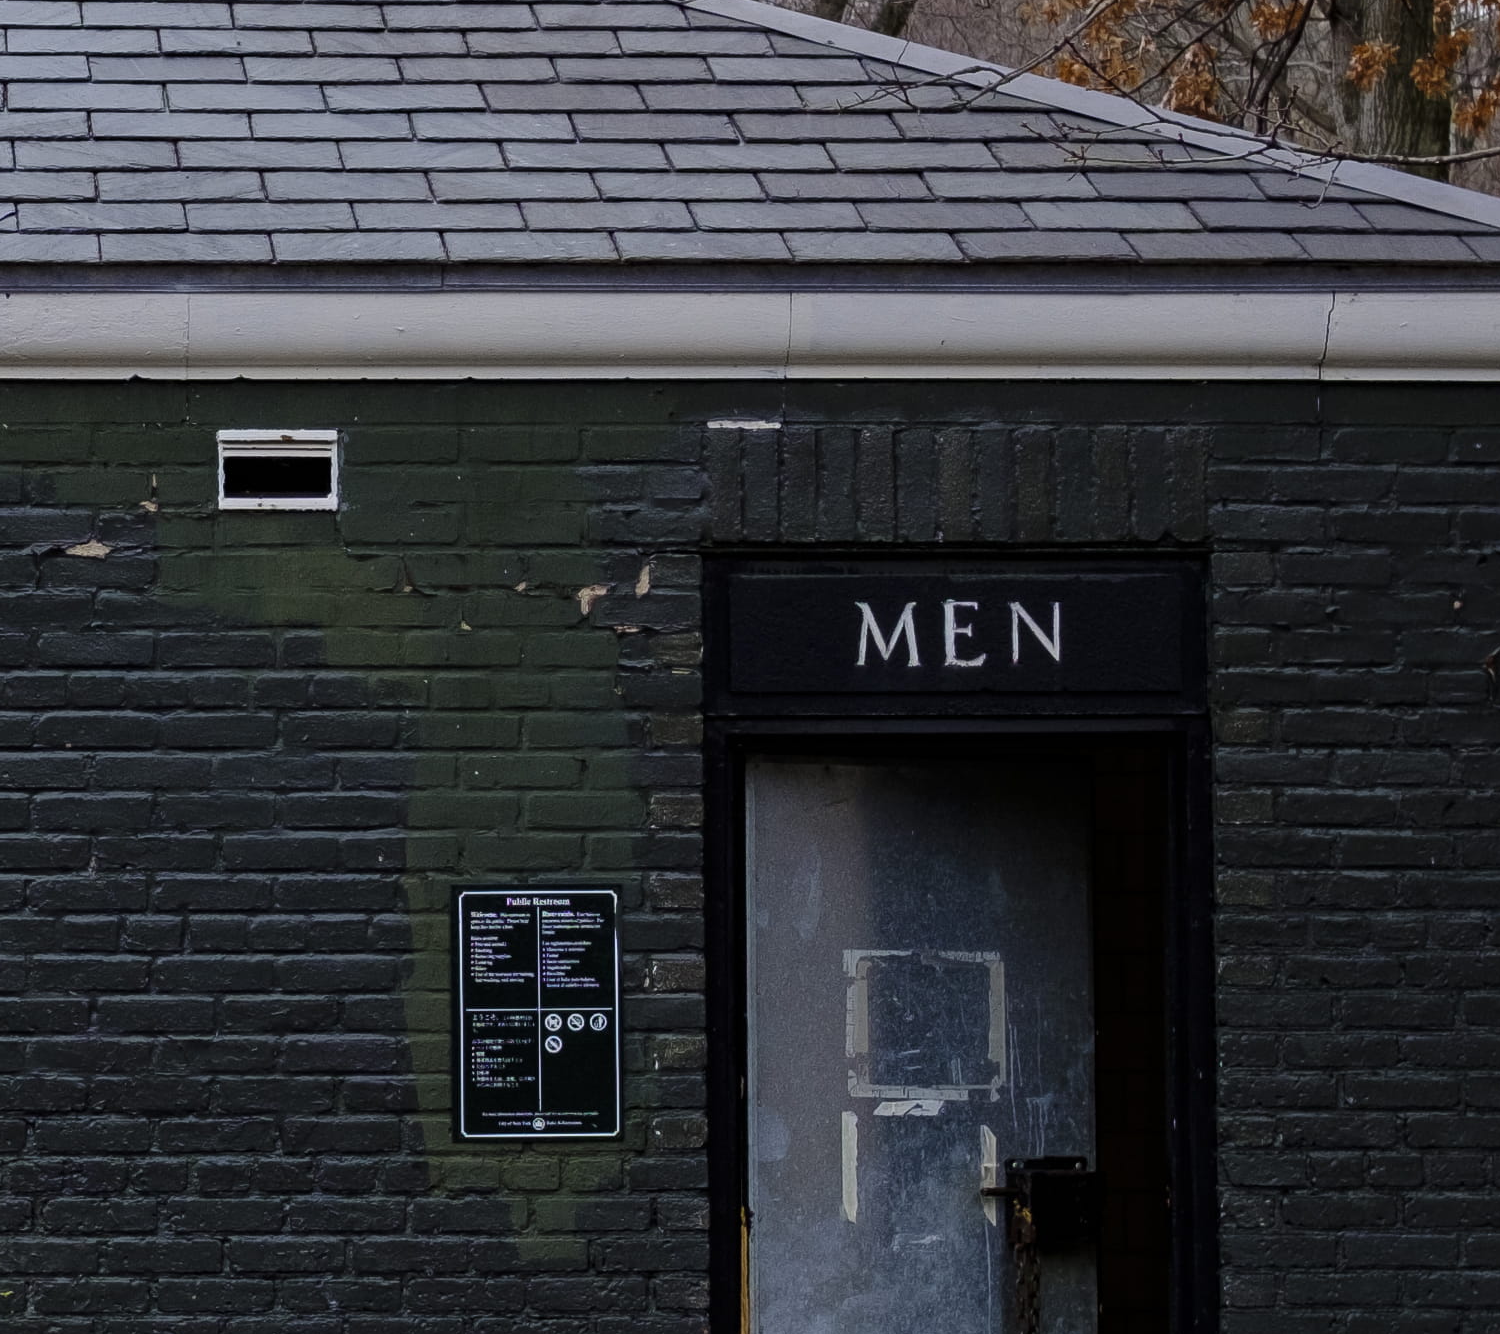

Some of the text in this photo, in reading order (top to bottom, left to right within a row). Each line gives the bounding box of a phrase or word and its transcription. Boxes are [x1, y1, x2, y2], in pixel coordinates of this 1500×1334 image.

[854, 598, 1063, 668] MEN
[506, 897, 571, 906] Public Restroom
